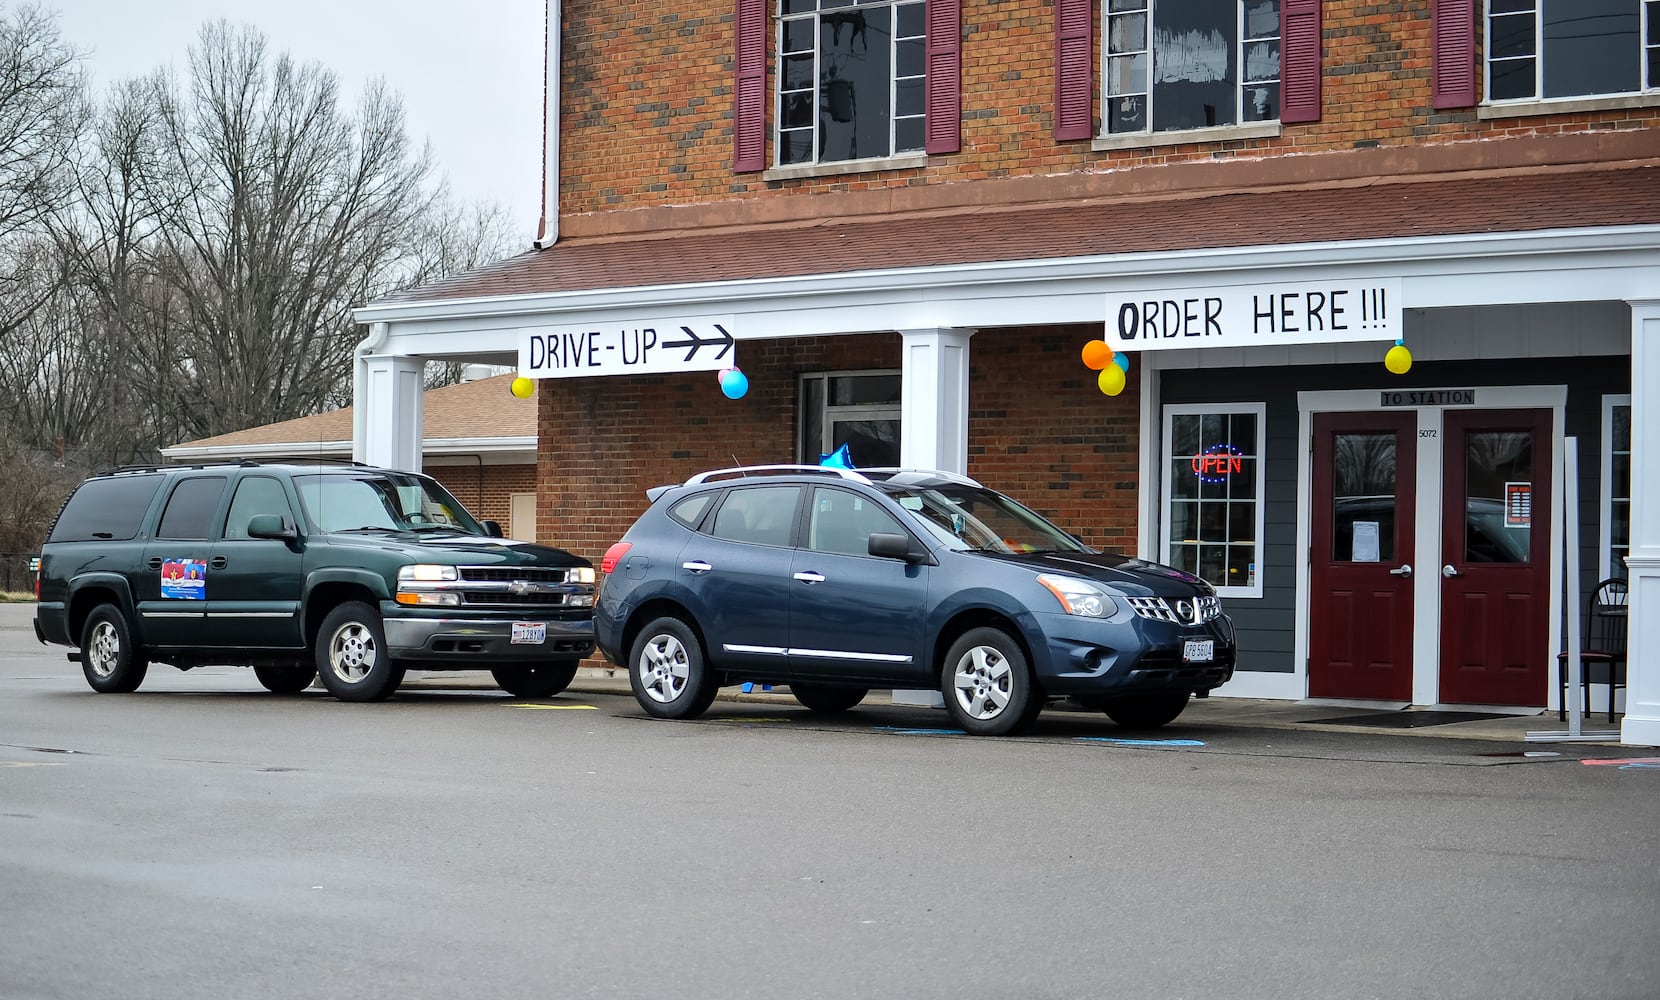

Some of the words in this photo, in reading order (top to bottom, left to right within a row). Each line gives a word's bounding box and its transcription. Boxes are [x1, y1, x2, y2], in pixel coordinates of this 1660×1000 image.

[1118, 297, 1223, 340] ORDER
[530, 328, 657, 370] DRIVE-UP
[1384, 393, 1402, 405] TO
[1409, 391, 1473, 404] STATION
[1418, 429, 1437, 438] 5072
[1191, 453, 1241, 473] OPEN
